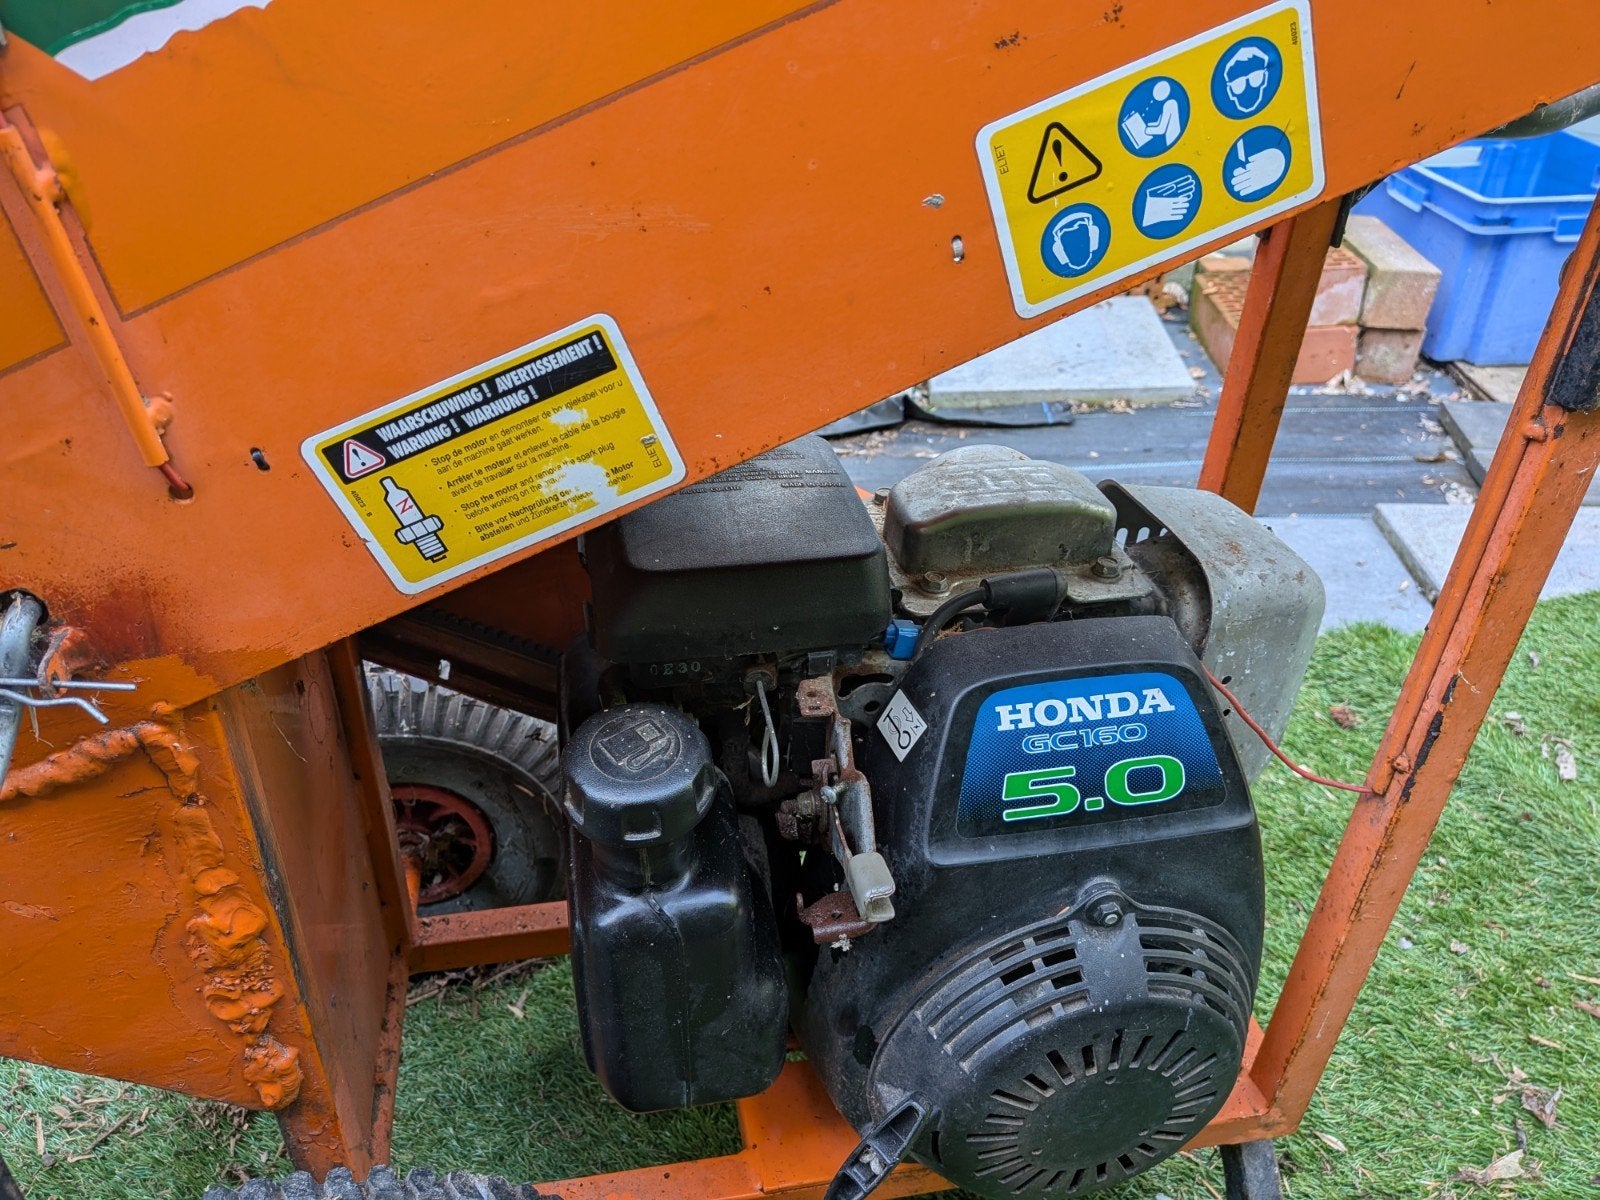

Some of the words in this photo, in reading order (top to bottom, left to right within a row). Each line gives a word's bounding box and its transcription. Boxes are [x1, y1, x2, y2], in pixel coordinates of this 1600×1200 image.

[993, 145, 1009, 175] ELIET
[431, 453, 452, 465] Stop
[453, 448, 463, 457] de
[464, 437, 488, 452] motor
[489, 432, 500, 441] en
[501, 415, 540, 436] demonteer
[542, 410, 552, 419] de
[599, 382, 615, 393] voor
[437, 464, 452, 474] aan
[453, 459, 463, 468] de
[464, 445, 496, 462] machine
[497, 437, 514, 451] gaat
[514, 425, 544, 441] werken.
[447, 472, 474, 488] Arrêter
[474, 468, 484, 476] le
[484, 456, 512, 472] moteur
[514, 451, 523, 459] et
[523, 441, 547, 456] enlever
[546, 436, 557, 445] le
[556, 427, 580, 441] cable
[581, 422, 591, 431] de
[600, 407, 626, 422] bougie
[451, 483, 473, 497] avant
[473, 479, 484, 487] de
[516, 460, 528, 469] sur
[538, 442, 572, 460] machine.
[461, 499, 481, 511] Stop
[480, 493, 495, 503] the
[495, 482, 519, 497] motor
[520, 475, 535, 486] and
[598, 442, 615, 454] plug
[465, 506, 490, 519] before
[490, 493, 520, 509] working
[520, 488, 530, 497] on
[530, 483, 542, 492] the
[475, 521, 495, 533] Bitte
[494, 515, 508, 524] vor
[508, 494, 560, 518] Nachprüfung
[610, 461, 634, 475] Motor
[480, 522, 515, 541] abstellen
[516, 515, 530, 526] und
[994, 687, 1176, 732] HONDA
[1022, 722, 1148, 754] GC160
[1002, 754, 1186, 822] 5.0
